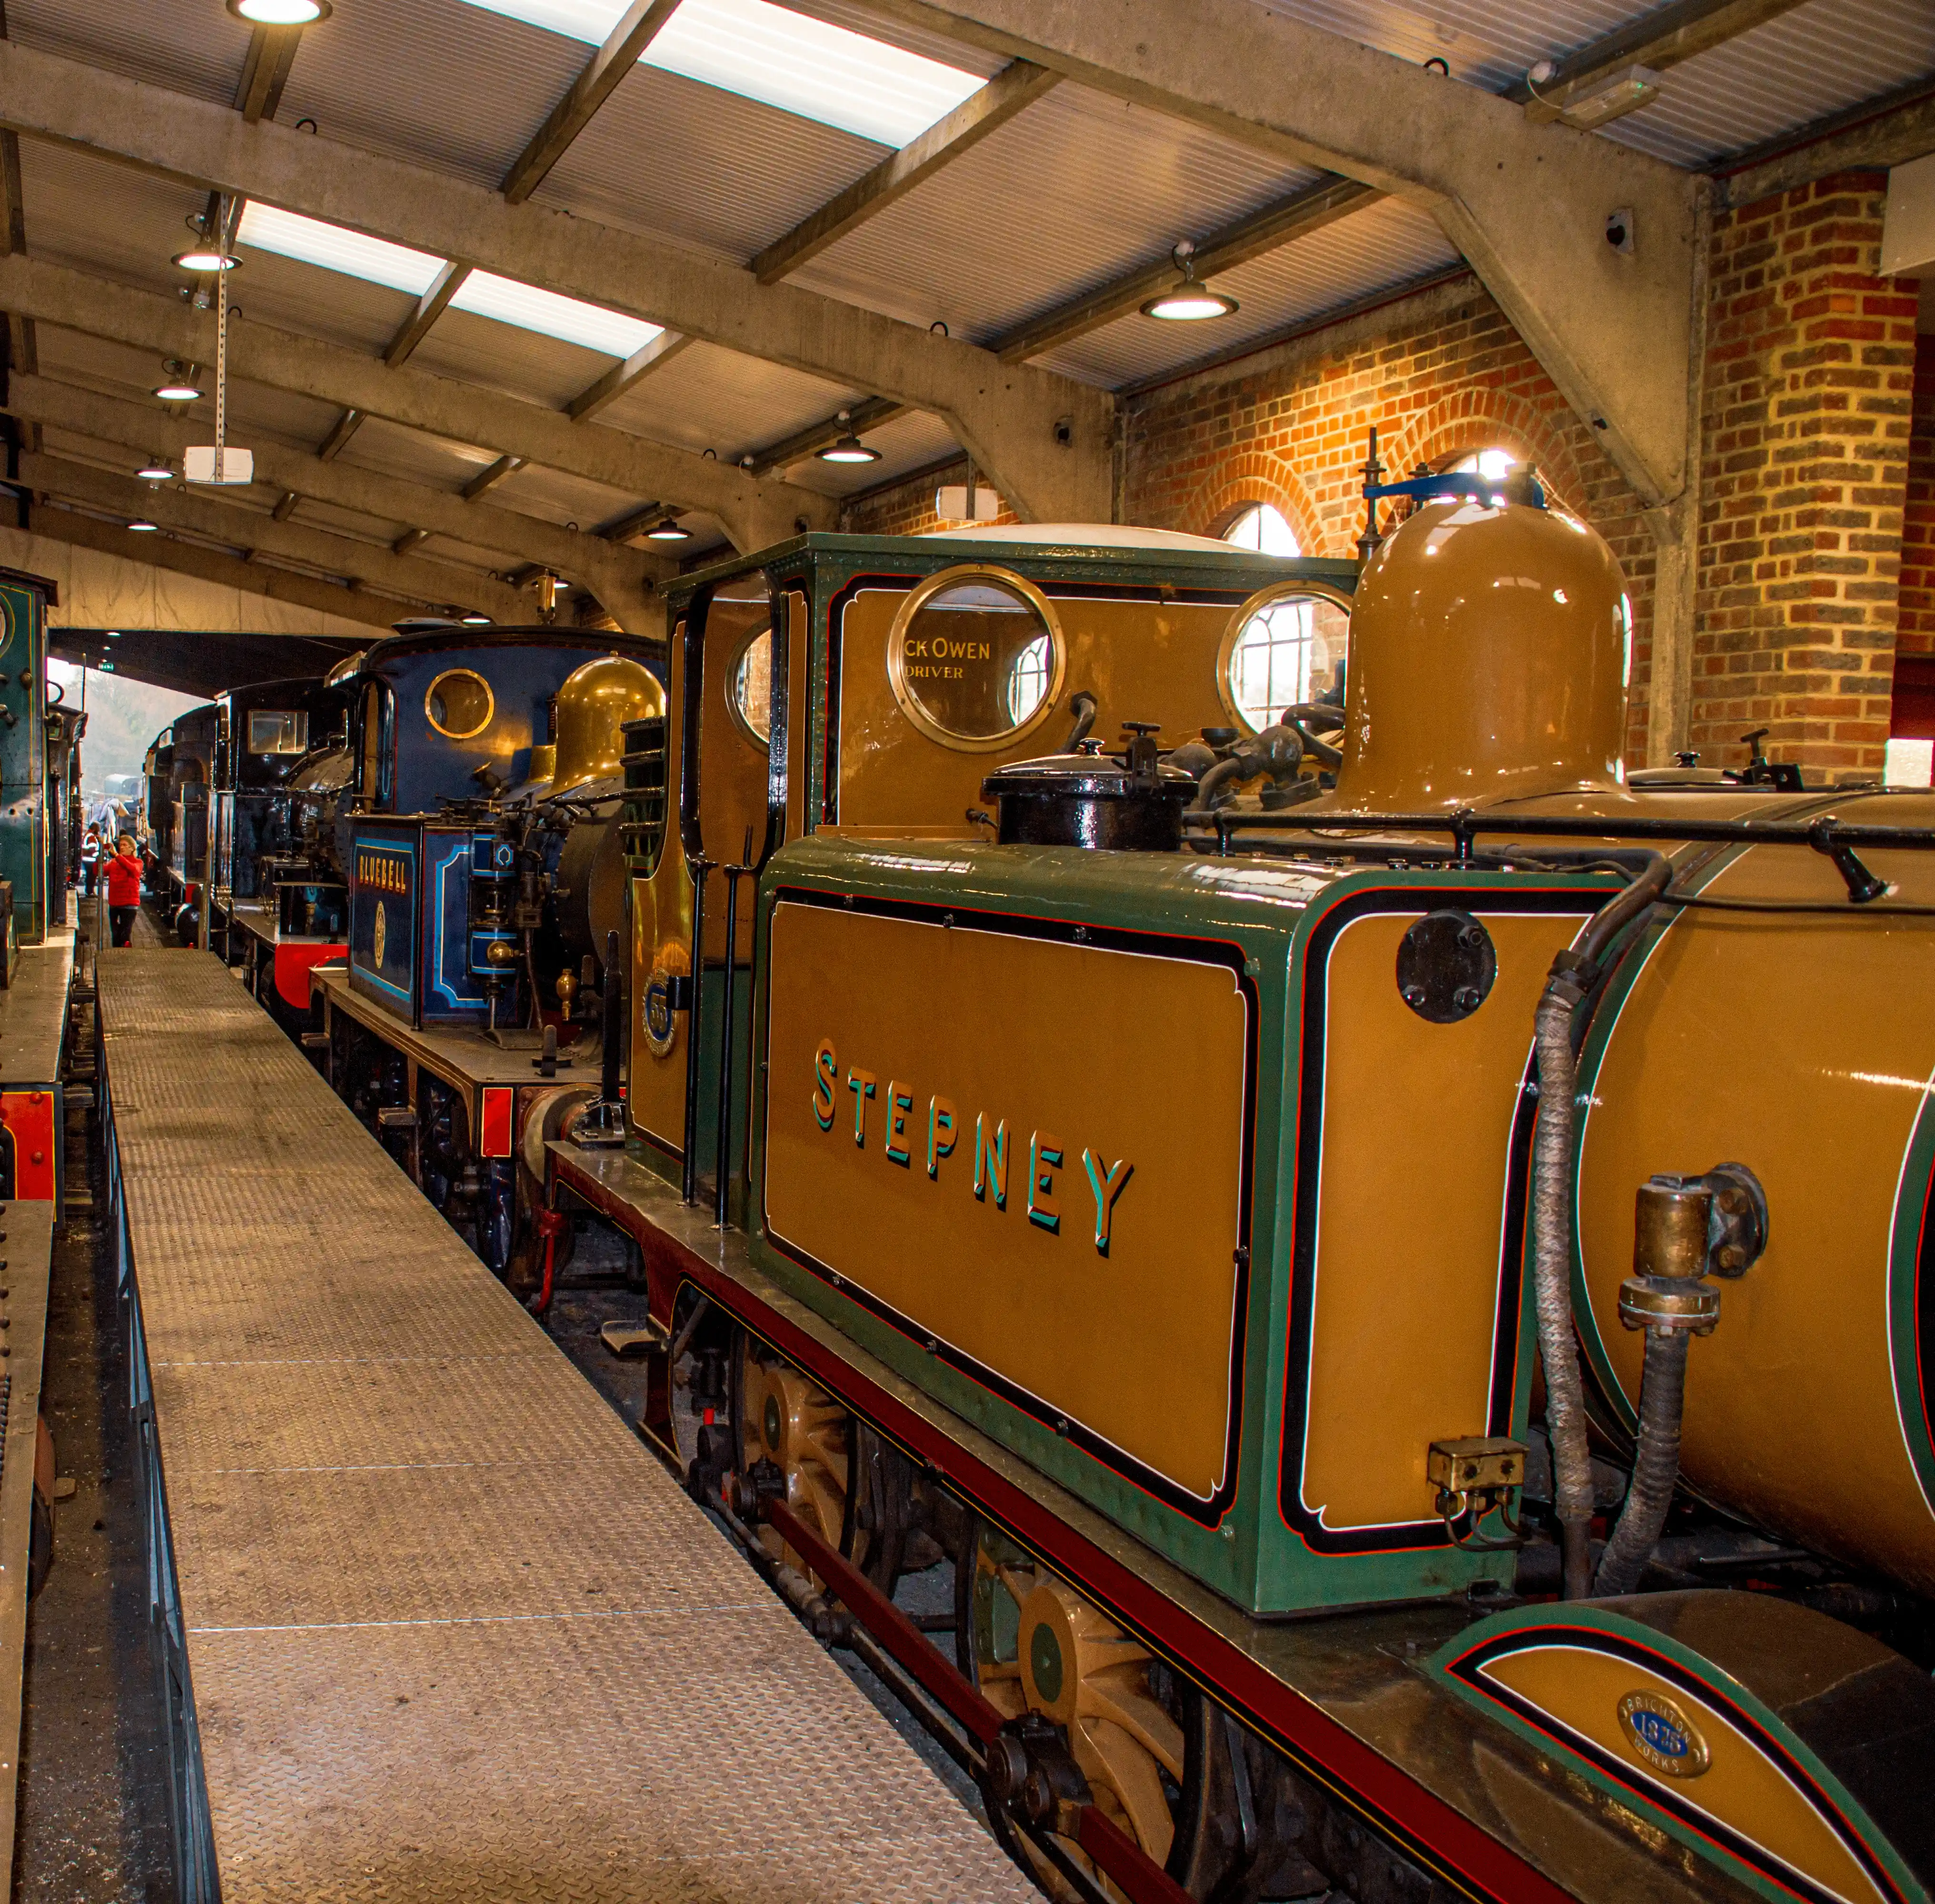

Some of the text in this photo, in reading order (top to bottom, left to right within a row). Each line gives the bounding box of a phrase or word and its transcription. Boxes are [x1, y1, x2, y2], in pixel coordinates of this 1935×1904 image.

[905, 666, 963, 679] DRIVER
[359, 855, 406, 894] BLUEBELL
[813, 1038, 1134, 1257] STEPNEY
[1627, 1696, 1691, 1744] BRIGHTON
[1635, 1735, 1680, 1772] WORKS
